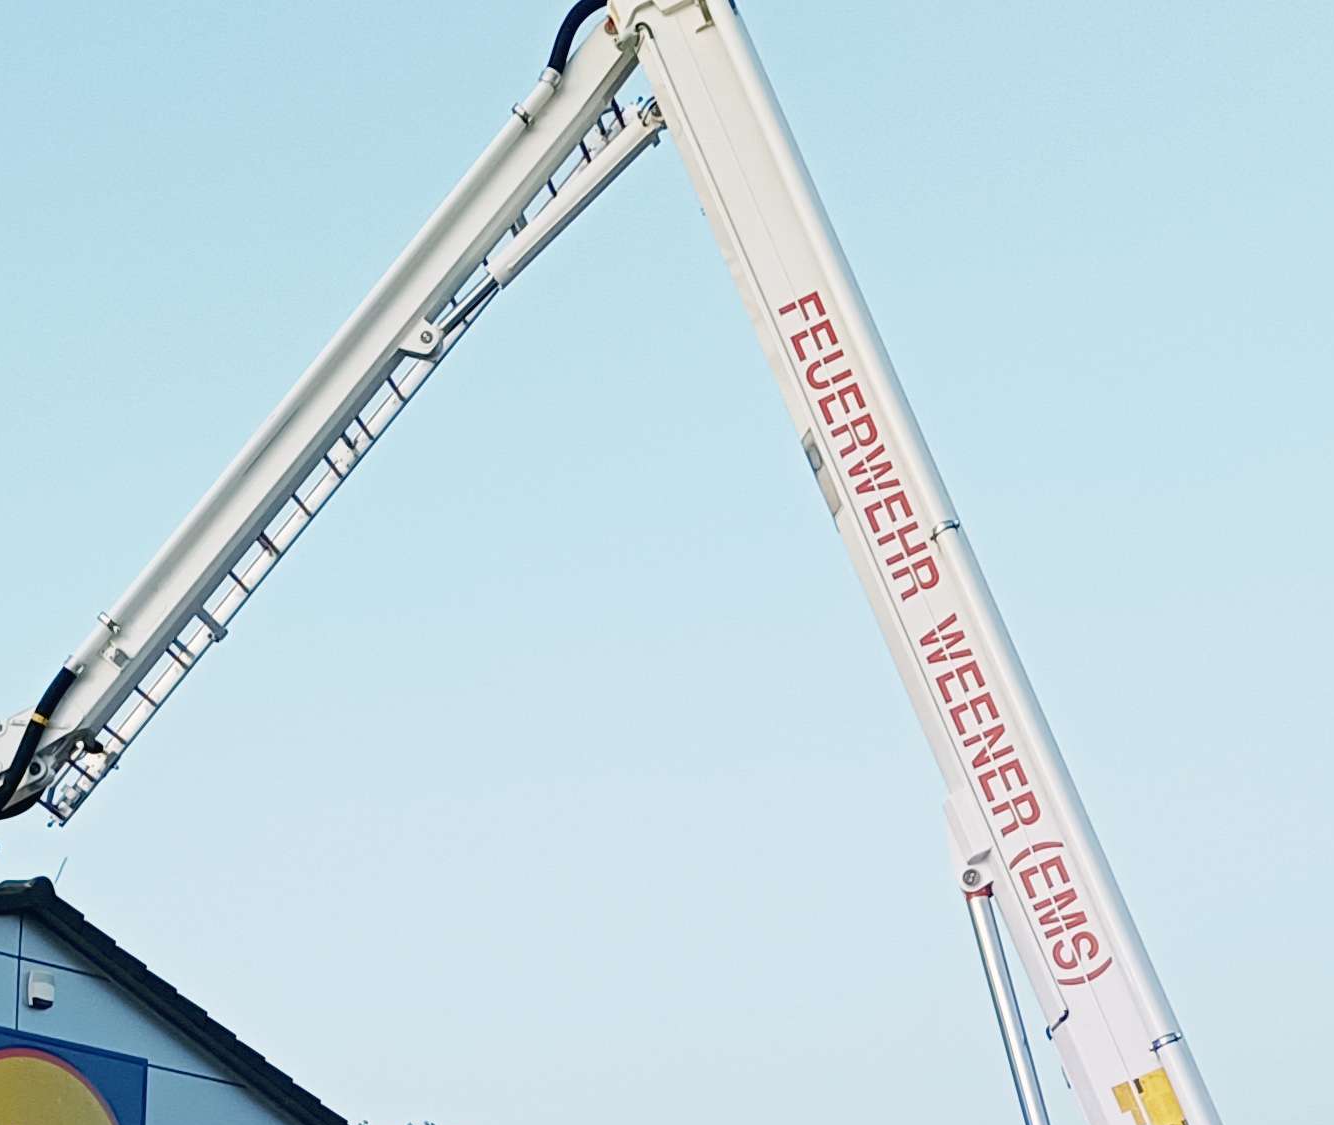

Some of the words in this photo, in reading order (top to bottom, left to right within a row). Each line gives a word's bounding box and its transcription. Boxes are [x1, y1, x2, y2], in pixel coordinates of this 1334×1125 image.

[778, 291, 940, 602] FEUERWEHR
[918, 612, 1042, 837] WEENER
[1008, 840, 1113, 988] (EMS)
